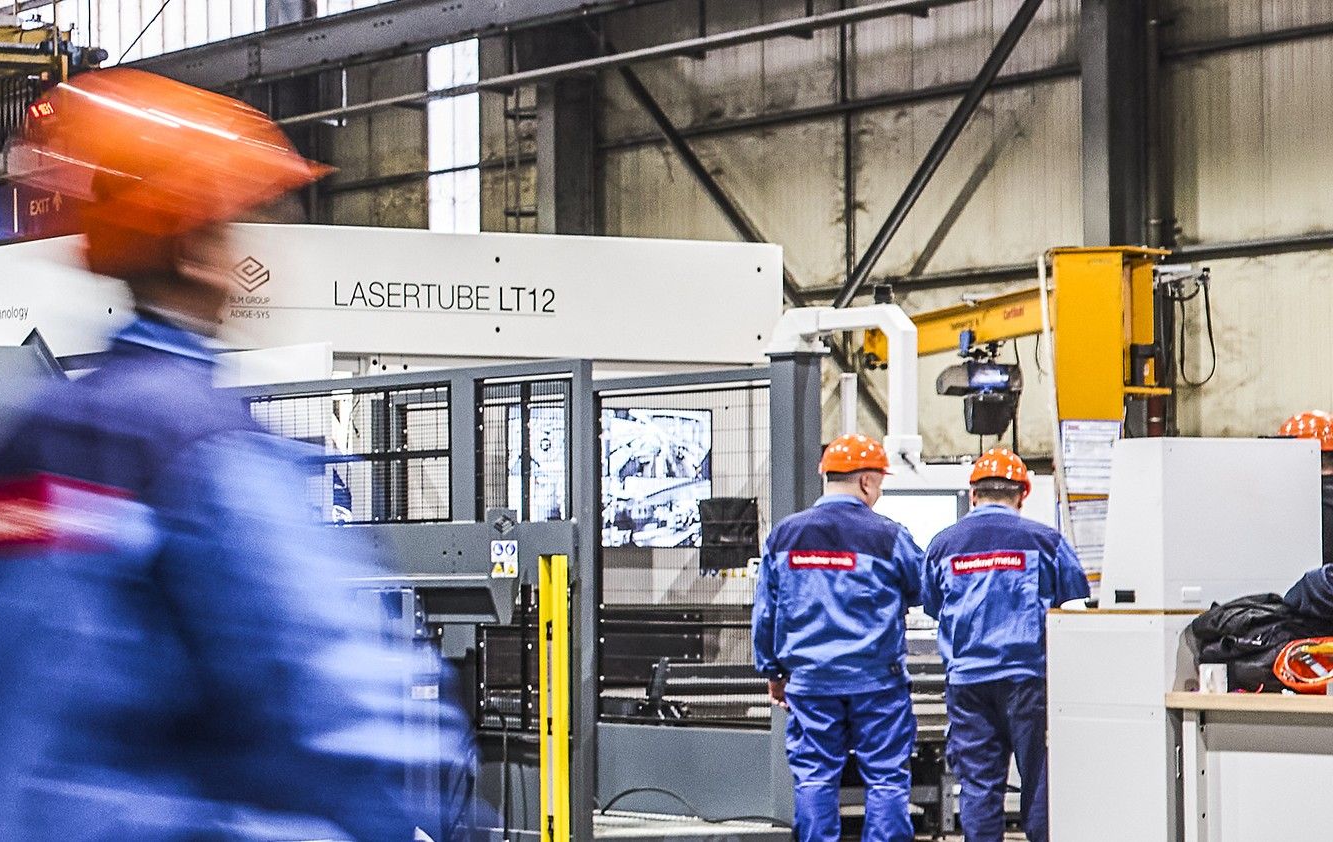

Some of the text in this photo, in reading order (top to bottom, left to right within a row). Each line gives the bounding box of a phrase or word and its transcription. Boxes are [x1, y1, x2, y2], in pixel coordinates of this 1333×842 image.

[29, 198, 50, 216] EXIT
[245, 296, 270, 304] GROUP
[334, 281, 556, 312] LASERTUBE LT12
[230, 310, 270, 319] ADIGE-SYS
